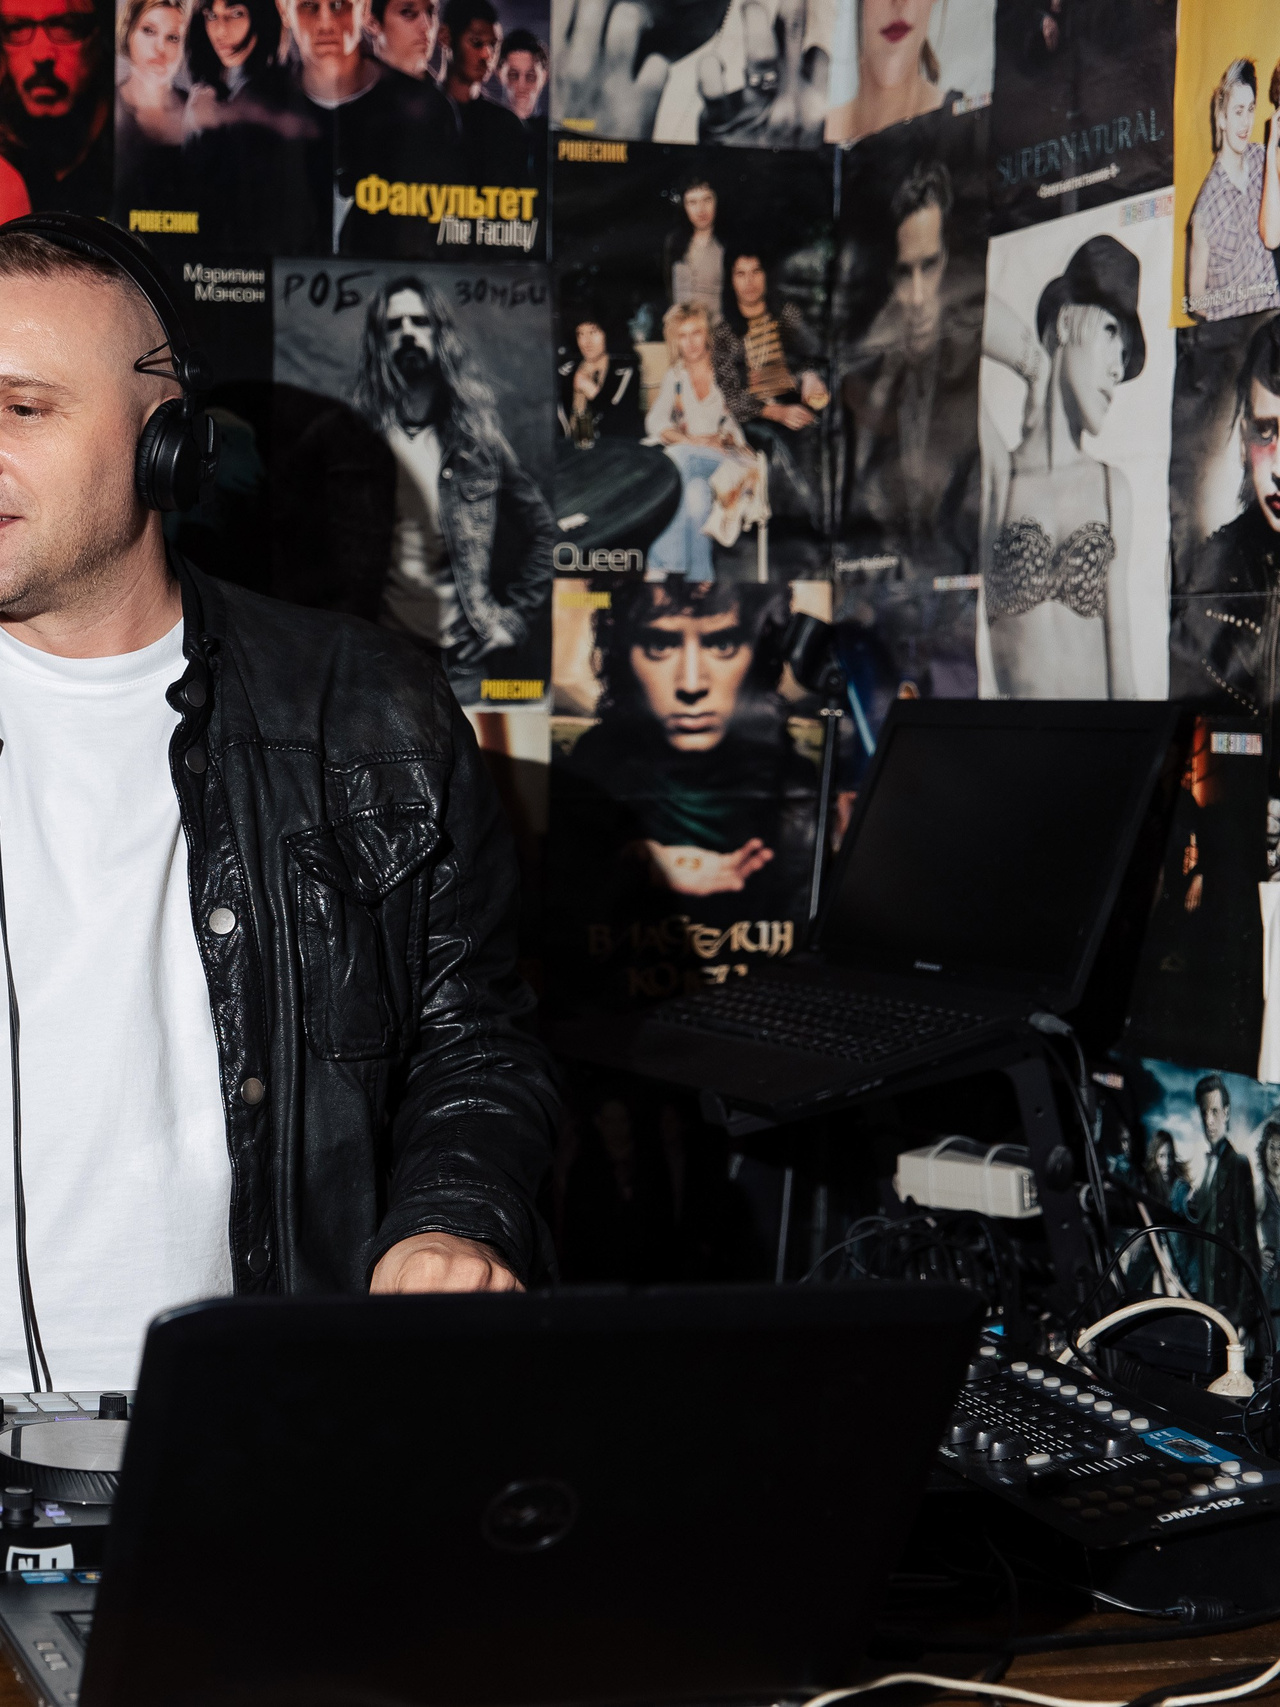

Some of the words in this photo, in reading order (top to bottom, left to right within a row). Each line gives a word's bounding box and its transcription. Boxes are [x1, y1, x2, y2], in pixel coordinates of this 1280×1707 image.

[996, 107, 1165, 187] SUPERNATURAL
[355, 174, 539, 224] Факультет
[553, 541, 644, 572] Queen
[1157, 1497, 1245, 1523] DMX-192
